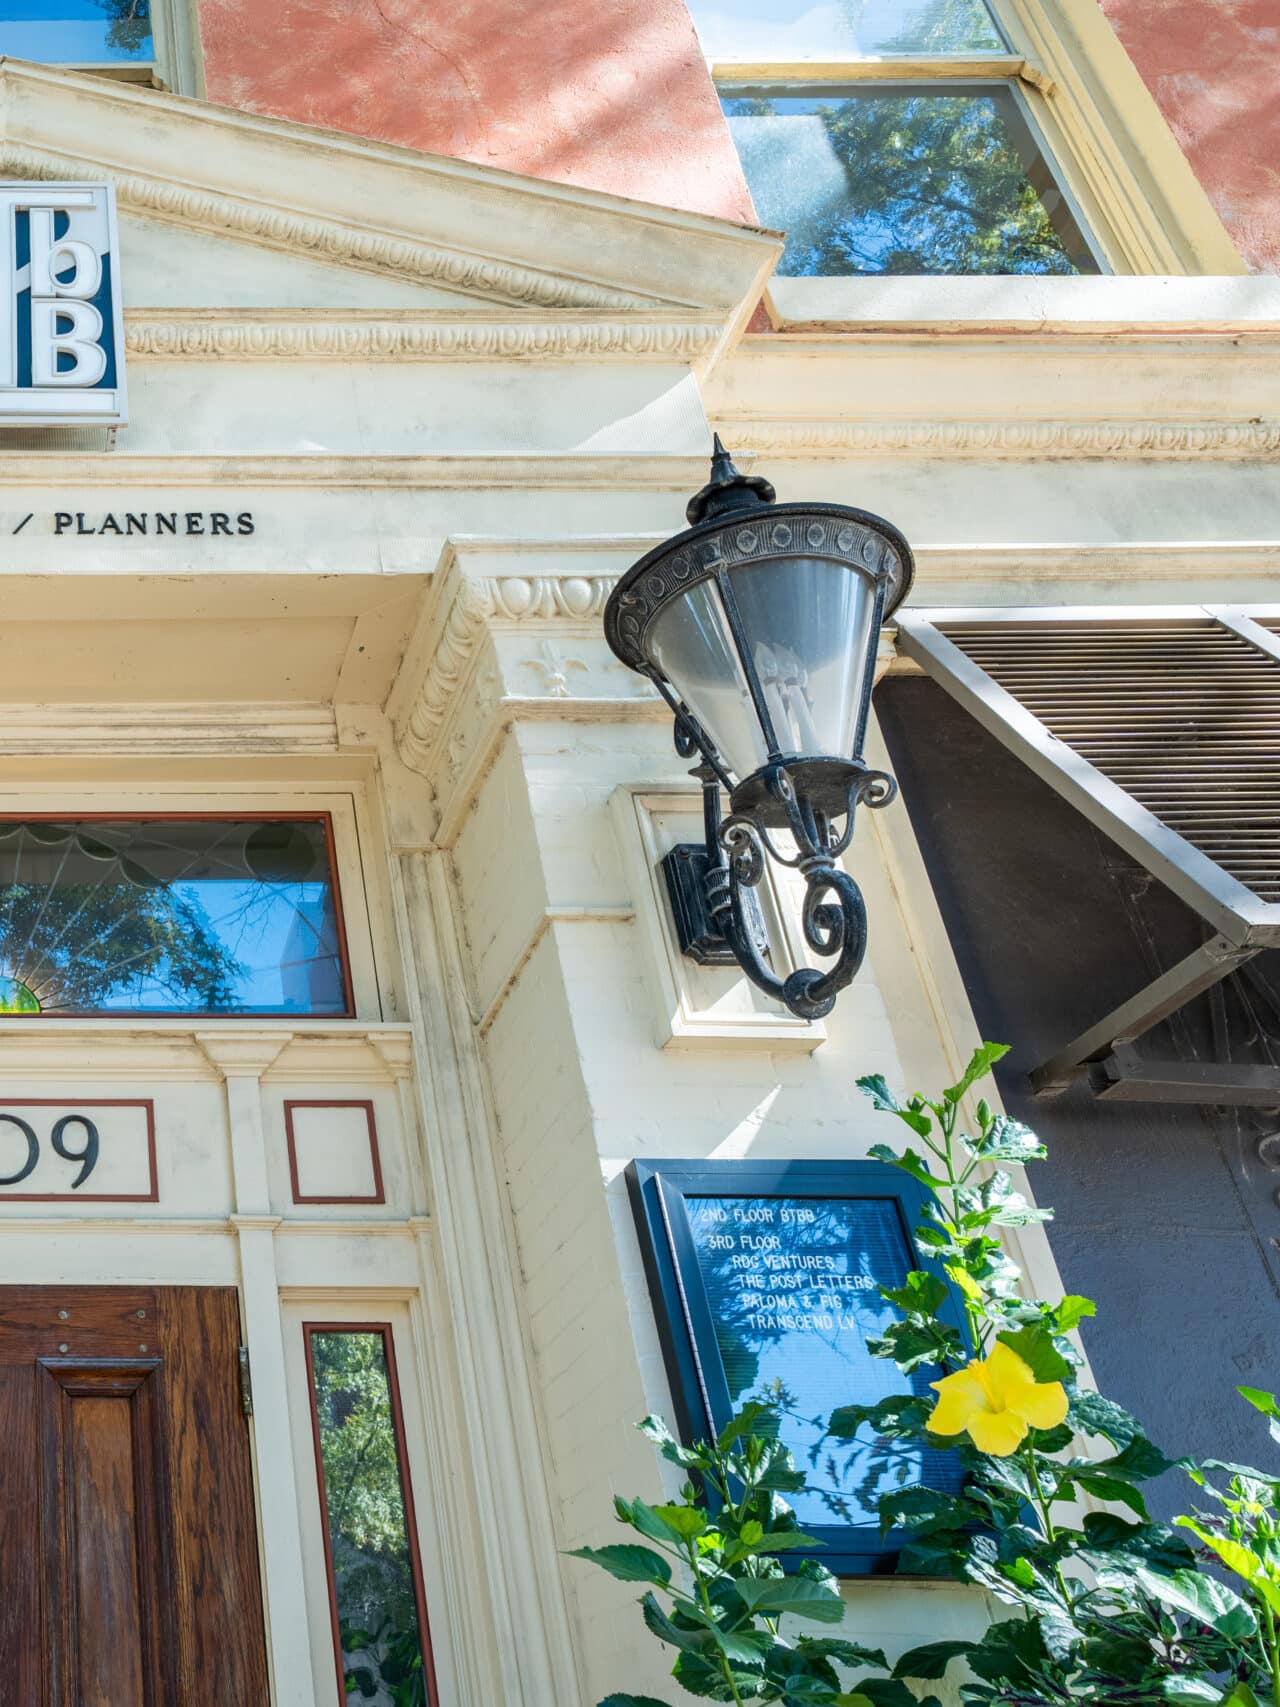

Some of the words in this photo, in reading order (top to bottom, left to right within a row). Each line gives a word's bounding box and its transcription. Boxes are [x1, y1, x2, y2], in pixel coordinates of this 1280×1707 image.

[12, 512, 34, 535] /
[53, 512, 256, 535] PLANNERS
[701, 1208, 728, 1223] 2ND
[733, 1208, 774, 1223] FLOOR
[780, 1208, 816, 1223] BTBB
[707, 1235, 735, 1250] 3RD
[740, 1235, 782, 1250] FLOOR
[763, 1255, 836, 1270] VENTURES
[737, 1274, 766, 1289] THE
[769, 1274, 803, 1289] POST
[809, 1275, 874, 1290] LETTERS
[742, 1294, 798, 1310] PALOMA
[821, 1294, 843, 1310] FIG
[747, 1314, 834, 1330] TRANSCEND
